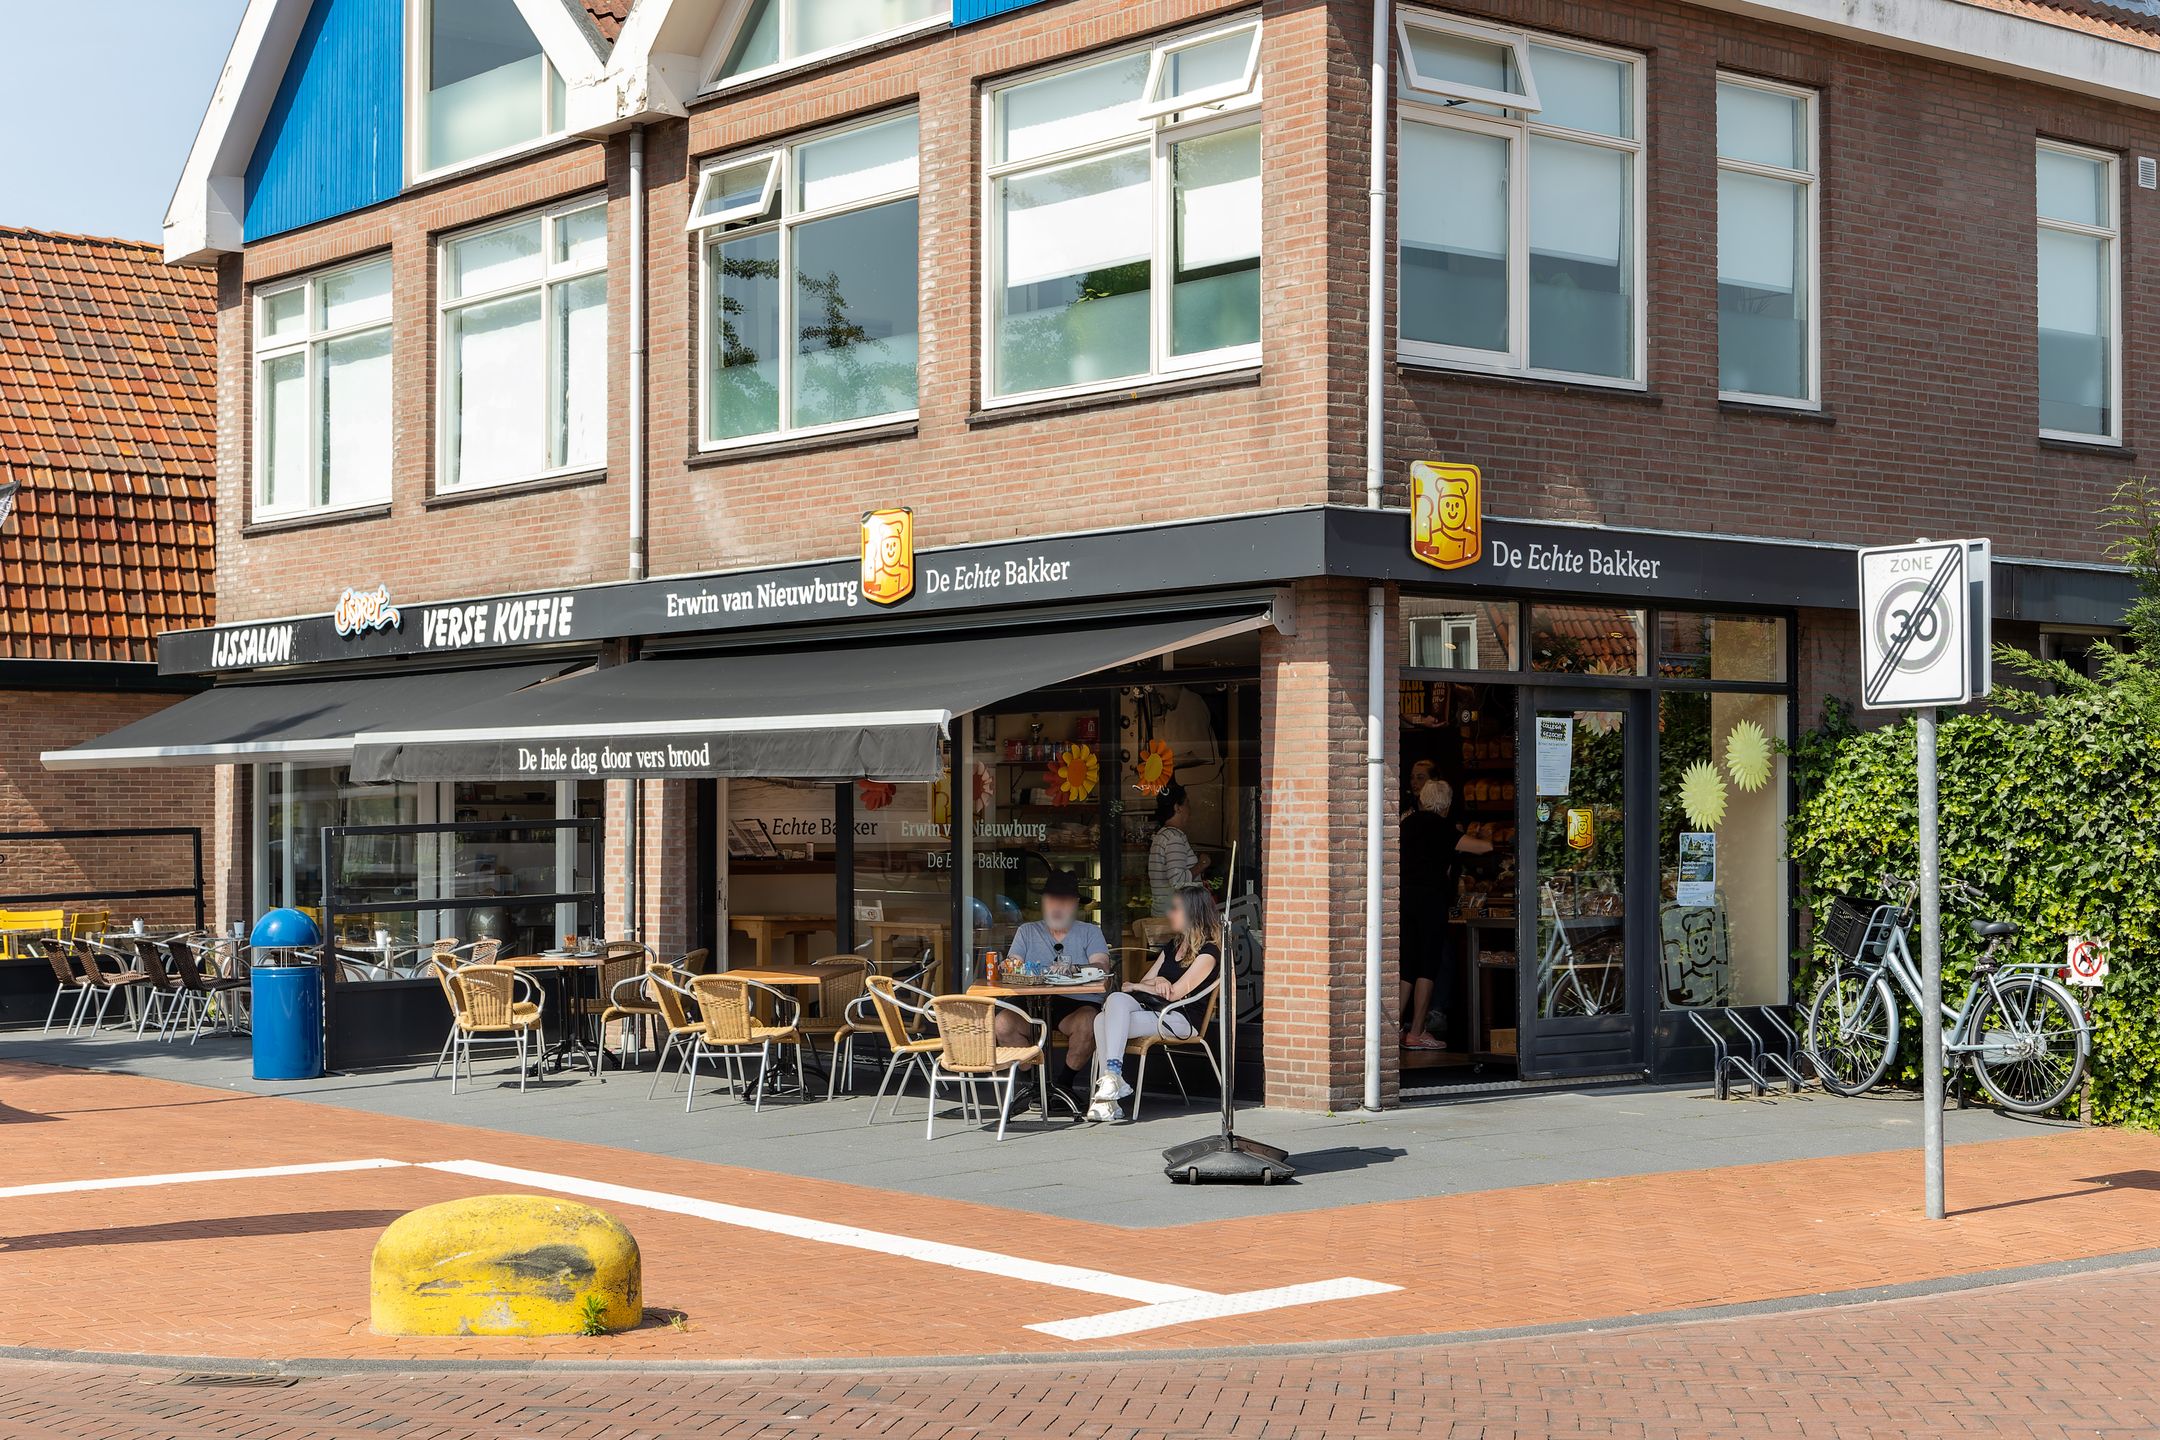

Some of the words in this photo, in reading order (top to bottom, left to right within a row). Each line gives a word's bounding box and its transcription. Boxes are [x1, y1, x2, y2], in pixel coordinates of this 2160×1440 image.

[926, 569, 950, 594] De
[954, 562, 1001, 591] Echte
[1004, 556, 1070, 586] Bakker
[1492, 540, 1522, 568] De
[1528, 543, 1584, 574] Echte
[1588, 548, 1661, 579] Bakker
[1890, 556, 1934, 573] ZONE
[666, 589, 719, 618] Erwin
[721, 590, 754, 612] van
[756, 577, 858, 607] Nieuwburg
[423, 606, 488, 648] VERSE
[493, 596, 574, 645] KOFFIE
[1890, 607, 1938, 643] 30
[211, 625, 292, 668] IJSSALON
[518, 748, 538, 770] De
[540, 747, 568, 770] hele
[571, 746, 598, 775] dag
[601, 746, 633, 768] door
[636, 750, 665, 768] vers
[667, 742, 710, 768] brood
[772, 817, 816, 836] Echte
[901, 820, 941, 837] Erwin
[928, 852, 943, 868] De
[978, 852, 1020, 870] Bakker
